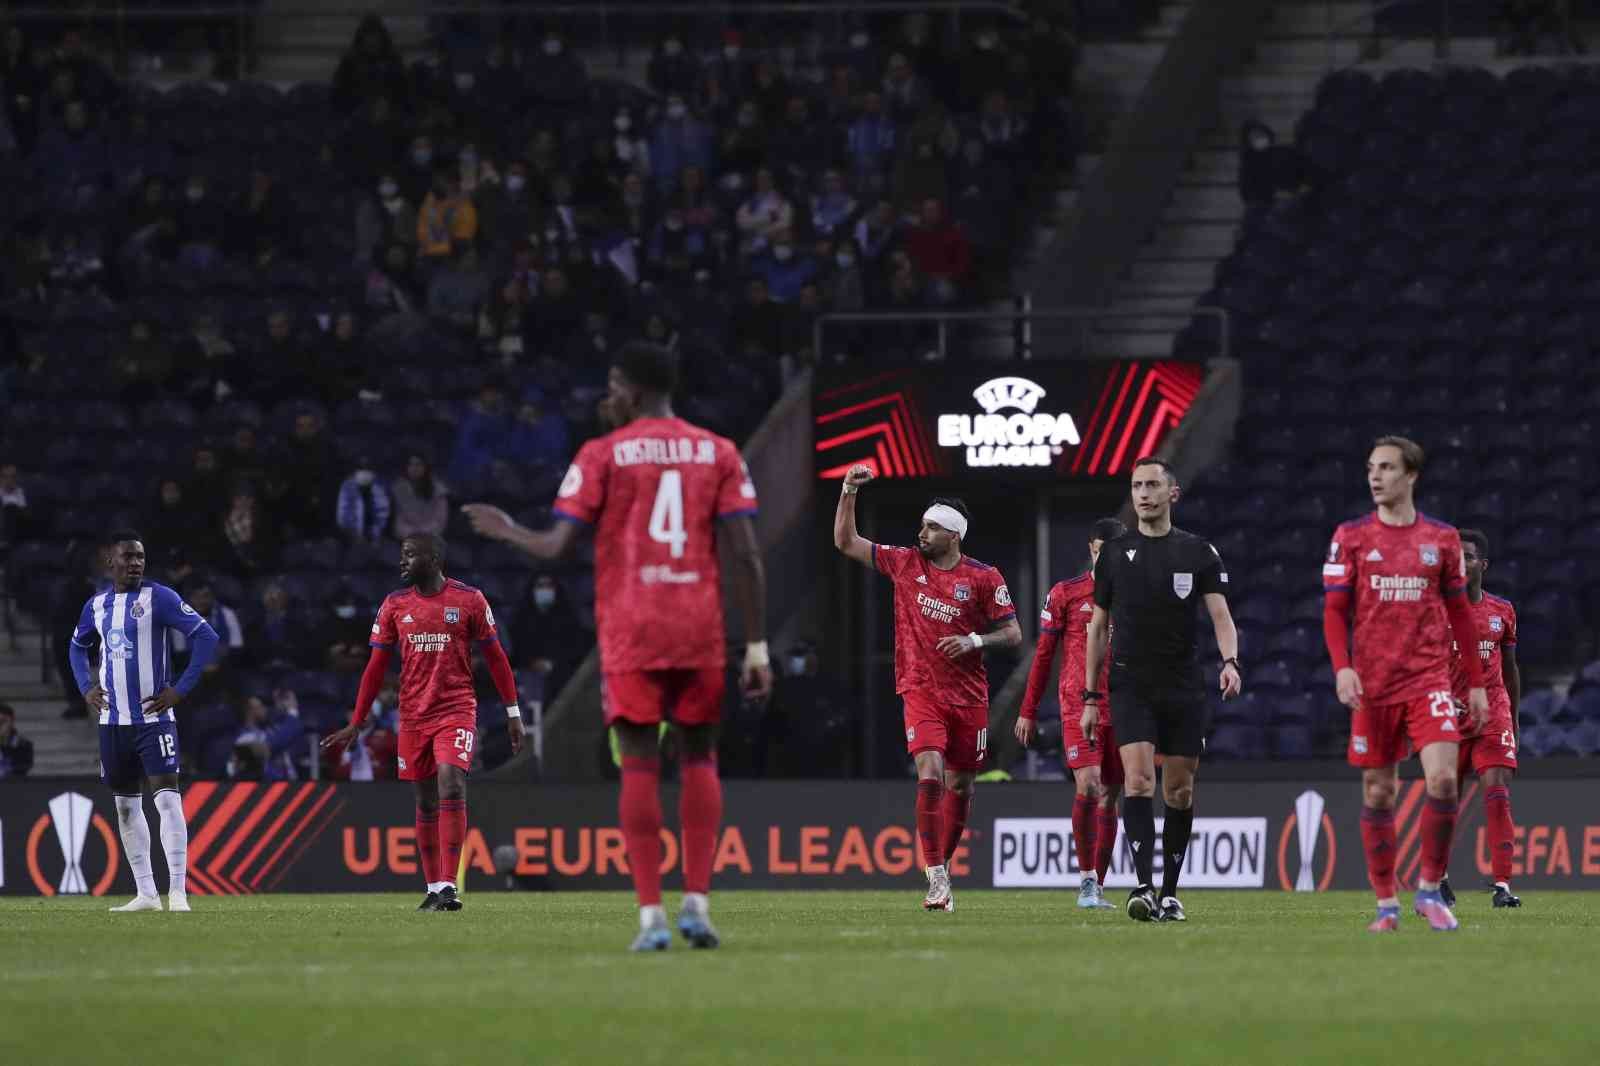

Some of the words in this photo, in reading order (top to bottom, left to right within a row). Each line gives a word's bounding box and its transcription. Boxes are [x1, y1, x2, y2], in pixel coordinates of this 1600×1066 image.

[938, 413, 1080, 446] EUROPA
[966, 445, 1052, 467] LEAGUE
[648, 469, 688, 558] 4
[917, 592, 961, 617] Emirates
[407, 631, 452, 644] Emirates
[1428, 691, 1456, 717] 25
[158, 734, 176, 757] 12
[454, 728, 474, 752] 28
[976, 727, 987, 751] 10
[343, 827, 496, 875] UEA
[768, 826, 970, 876] LEAGE
[1000, 832, 1079, 875] PURE
